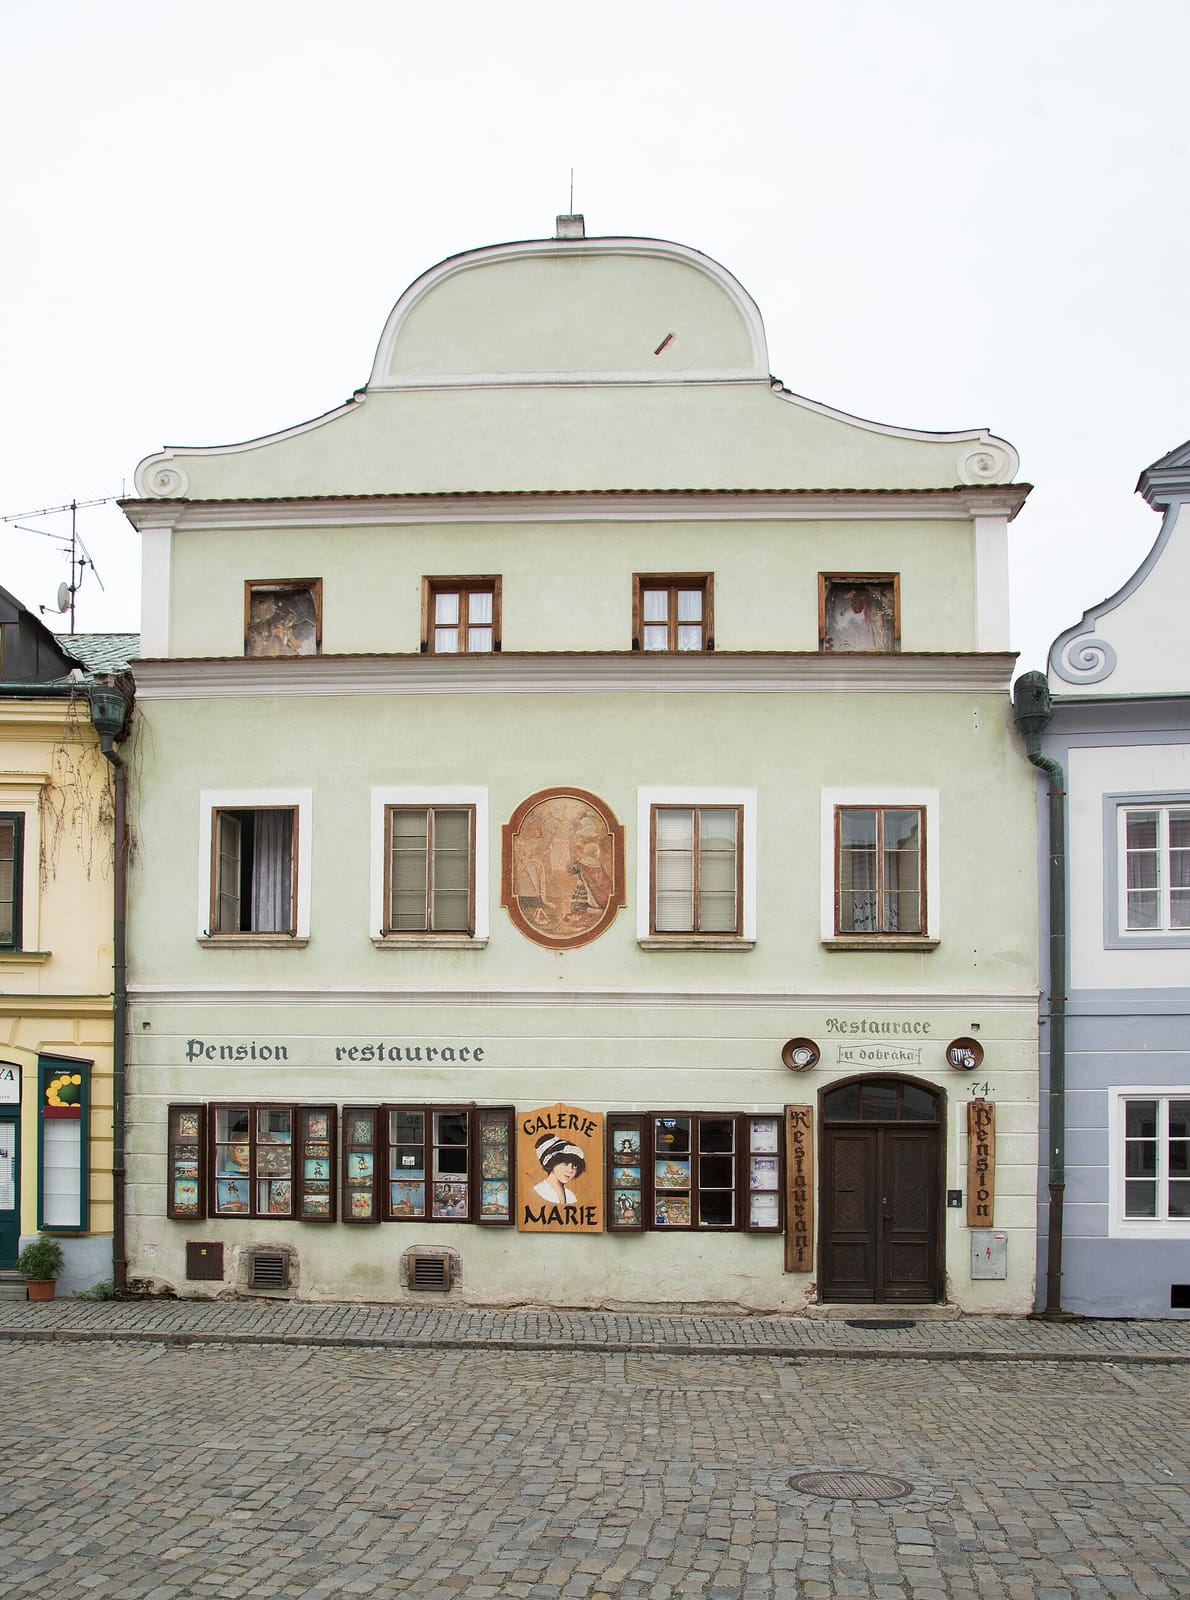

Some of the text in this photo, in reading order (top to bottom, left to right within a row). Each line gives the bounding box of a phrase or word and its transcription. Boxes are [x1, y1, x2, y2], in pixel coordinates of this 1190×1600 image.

[826, 1018, 931, 1034] Restaurace
[186, 1038, 485, 1063] Pension restaurace
[523, 1113, 597, 1137] GALERIE
[974, 1106, 991, 1216] Pension
[791, 1110, 810, 1262] Restaurant
[524, 1205, 598, 1225] MARIE
